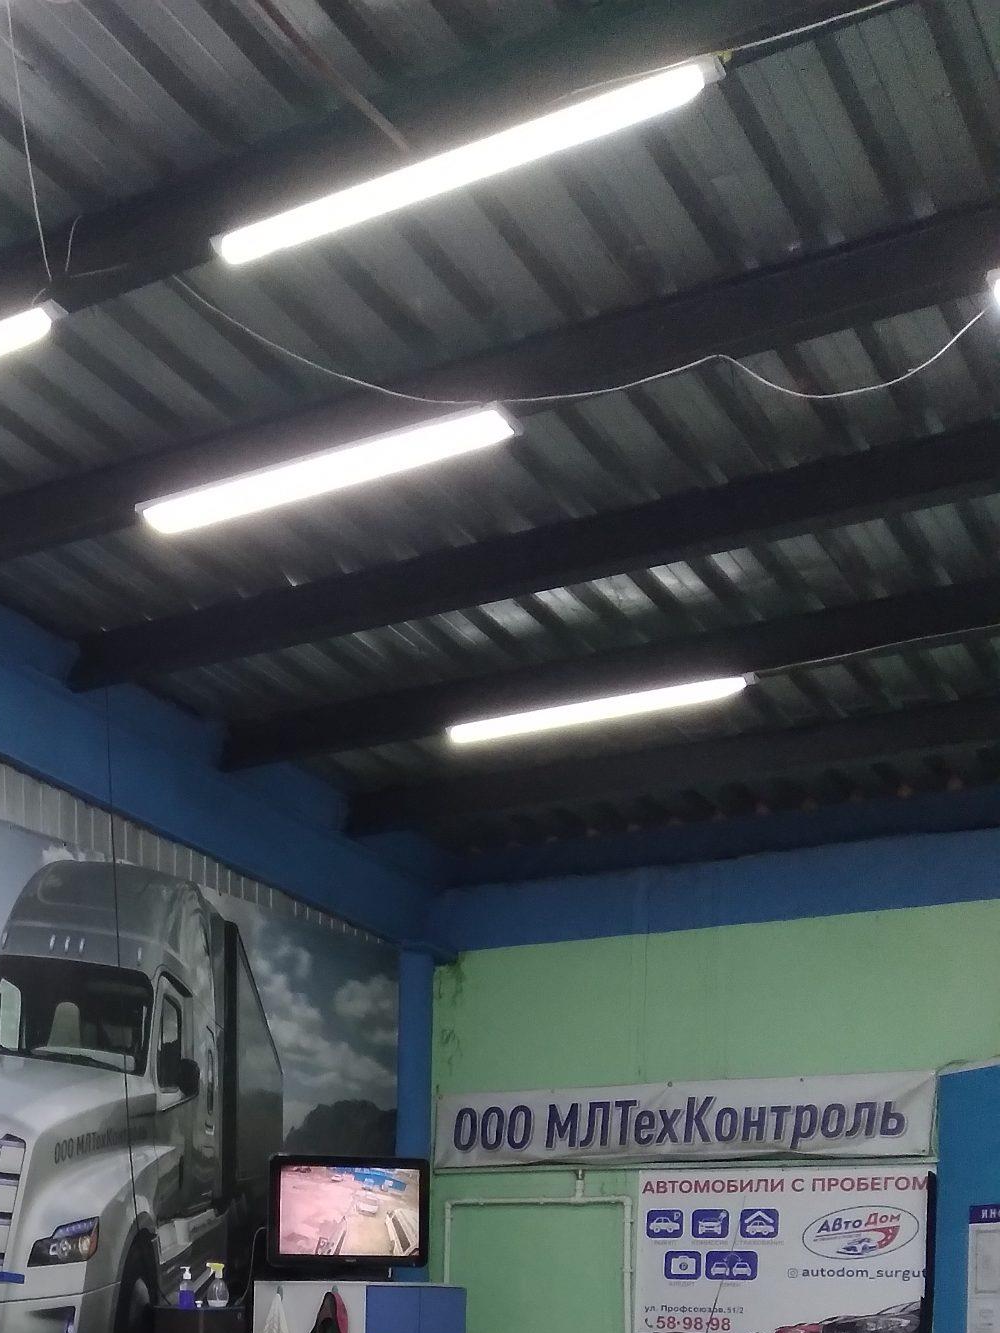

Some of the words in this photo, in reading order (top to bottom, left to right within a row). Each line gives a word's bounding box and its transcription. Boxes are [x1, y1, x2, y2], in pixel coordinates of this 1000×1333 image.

[453, 1104, 534, 1152] ООО
[545, 1096, 907, 1150] МЛТехКонтроль
[641, 1178, 785, 1194] АВТОМОБИЛИ
[791, 1178, 805, 1192] С
[811, 1176, 929, 1192] ПРОБЕГОМ
